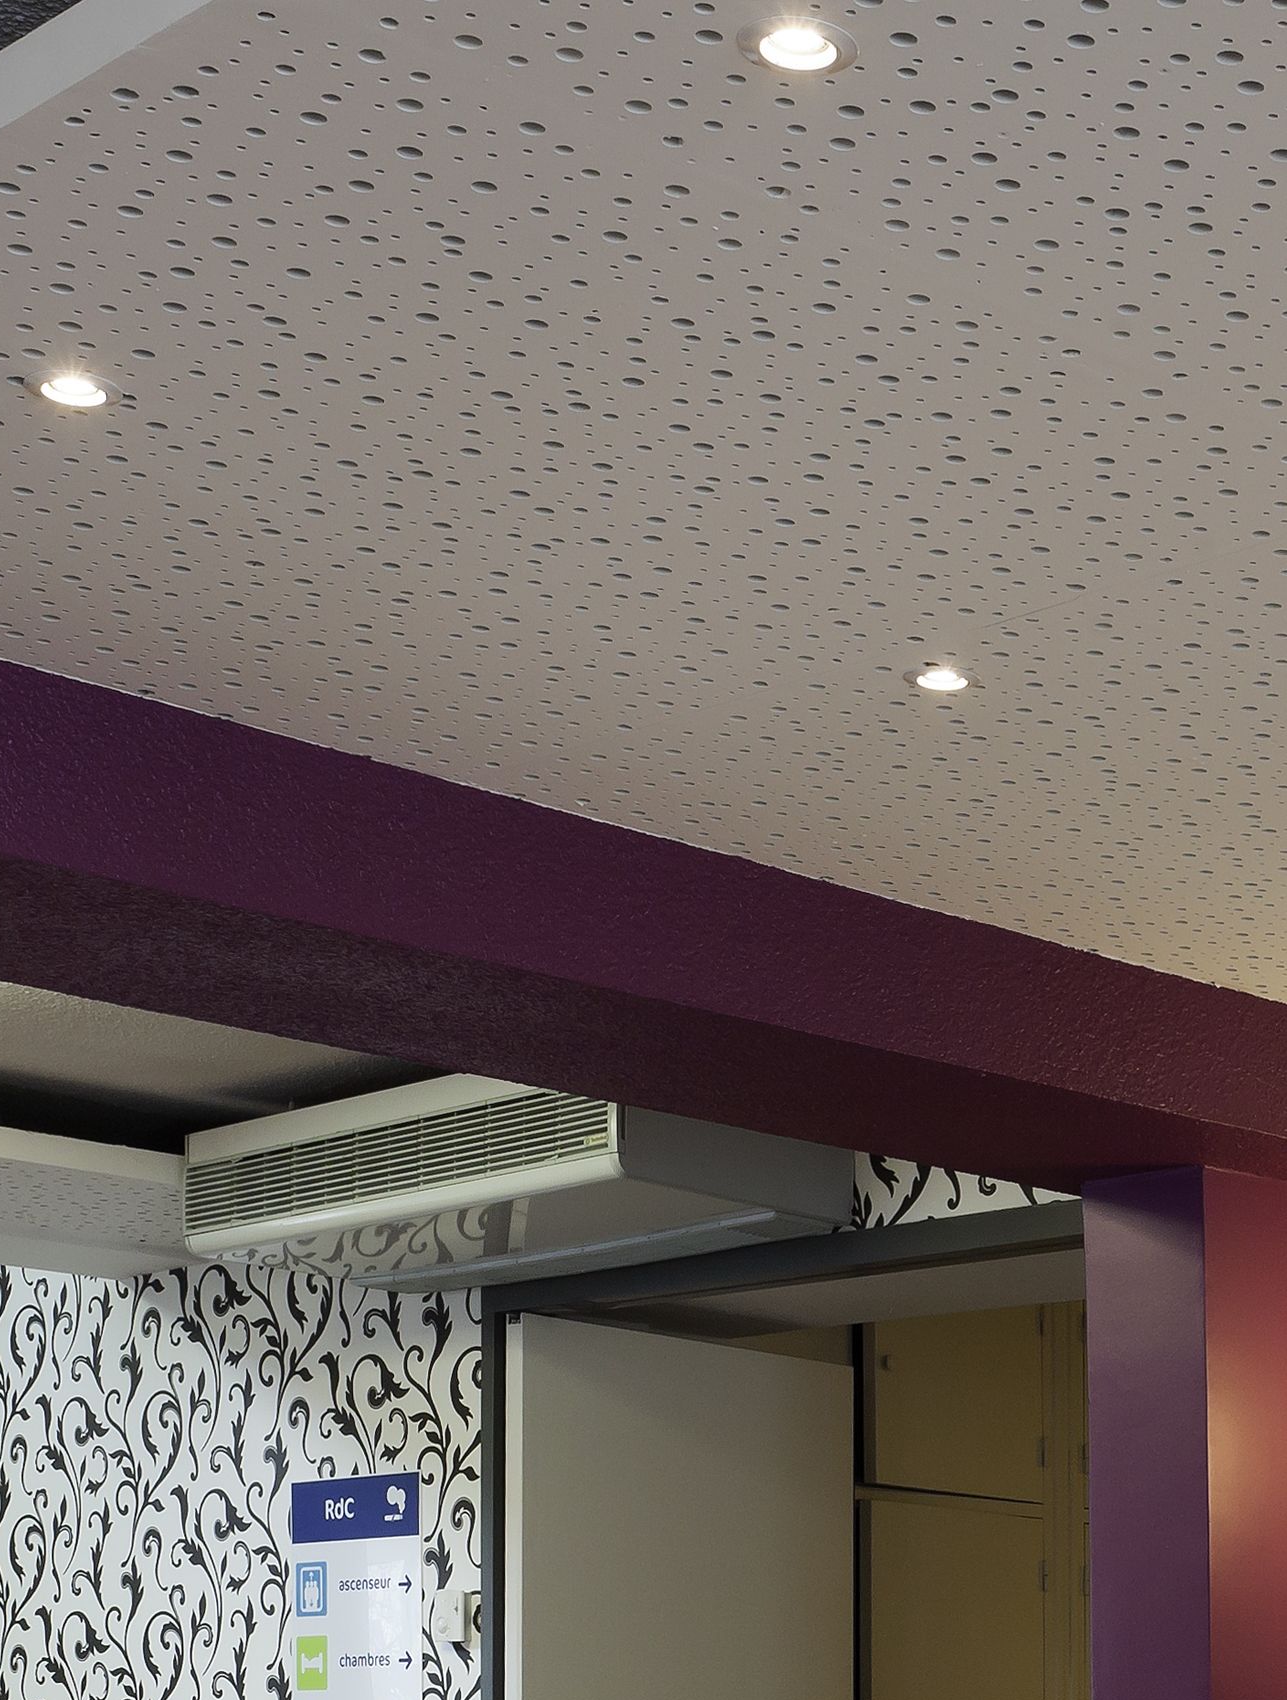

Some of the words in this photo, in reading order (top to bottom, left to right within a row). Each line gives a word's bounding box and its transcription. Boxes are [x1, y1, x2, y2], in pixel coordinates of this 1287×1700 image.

[325, 1497, 355, 1520] RdC
[339, 1578, 391, 1591] ascenseur
[339, 1652, 391, 1667] chambres
